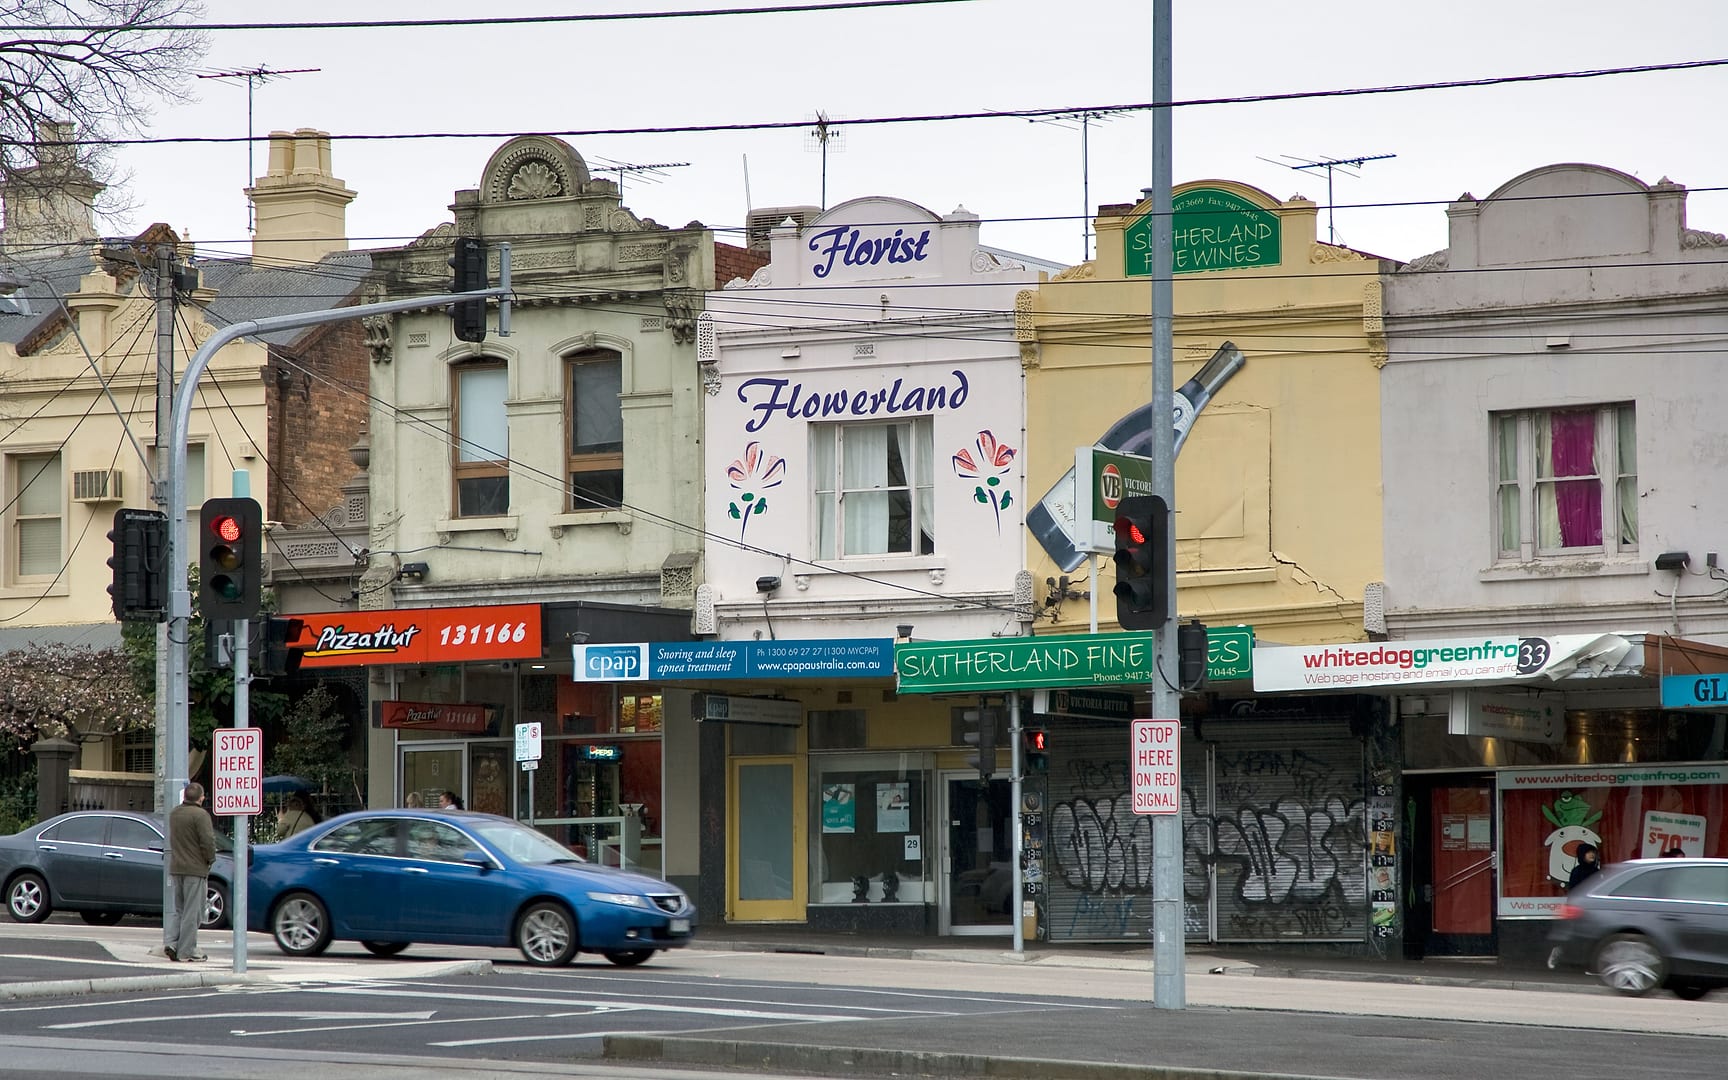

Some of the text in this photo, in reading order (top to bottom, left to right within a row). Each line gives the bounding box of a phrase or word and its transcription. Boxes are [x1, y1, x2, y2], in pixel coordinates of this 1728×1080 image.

[1208, 196, 1224, 206] Fax:
[1132, 223, 1272, 250] SHERLAND
[809, 226, 931, 278] Florist
[1193, 244, 1261, 266] WINES
[738, 370, 969, 433] Flowerland
[1102, 475, 1120, 499] VB
[1124, 477, 1152, 493] VICTORI
[440, 621, 526, 646] 131166
[657, 645, 737, 662] Snoring and sleep
[757, 646, 879, 656] Ph 1300 69 27 27 (1300 MYCPAP)
[1304, 641, 1518, 669] whitedoggreenfro
[1518, 644, 1547, 668] 33
[589, 655, 637, 678] cpap
[757, 658, 880, 673] www.cpapaustralia.com.au
[902, 648, 1079, 678] SUTHERLAND
[1087, 643, 1144, 670] FINE
[657, 662, 731, 676] apnea treatment
[1304, 662, 1518, 685] Web page hosting and email you can affo
[1093, 672, 1123, 682] Phone:
[1070, 695, 1102, 710] VICTORIA
[221, 735, 254, 750] STOP
[1140, 727, 1173, 743] STOP
[219, 756, 255, 771] HERE
[1139, 750, 1174, 766] HERE
[216, 776, 258, 790] ON RED
[1136, 772, 1177, 786] ON RED
[1514, 770, 1721, 785] www.whitedoggreenfrog.com
[217, 795, 258, 808] SIGNAL
[1136, 793, 1176, 807] SIGNAL
[907, 840, 918, 849] 29
[1510, 901, 1534, 910] Web
